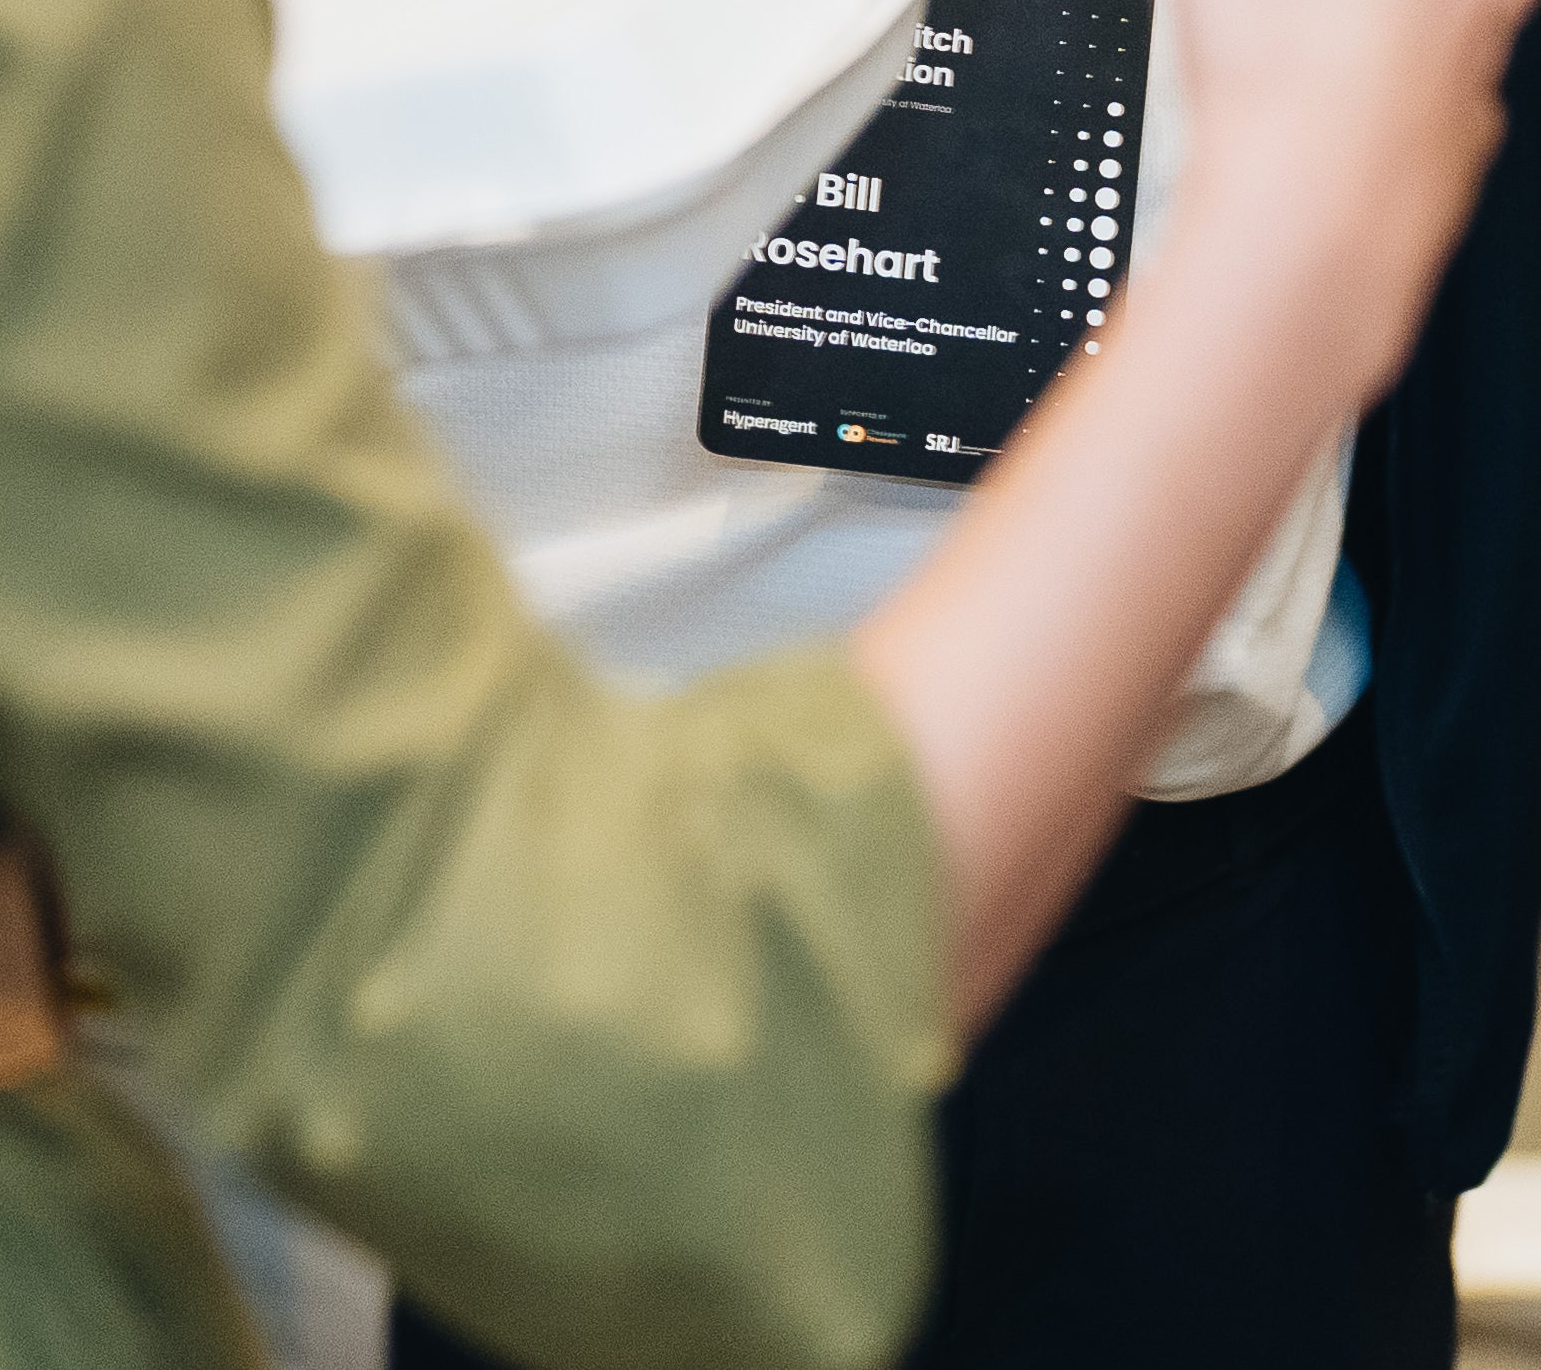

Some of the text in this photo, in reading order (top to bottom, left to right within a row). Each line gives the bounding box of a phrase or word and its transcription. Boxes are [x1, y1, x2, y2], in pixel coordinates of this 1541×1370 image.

[912, 22, 974, 55] itch
[816, 172, 883, 213] Bill
[733, 318, 938, 356] University of Waterloo
[735, 296, 1020, 344] President and Vice-Chancellor
[722, 409, 817, 436] Hyperagent
